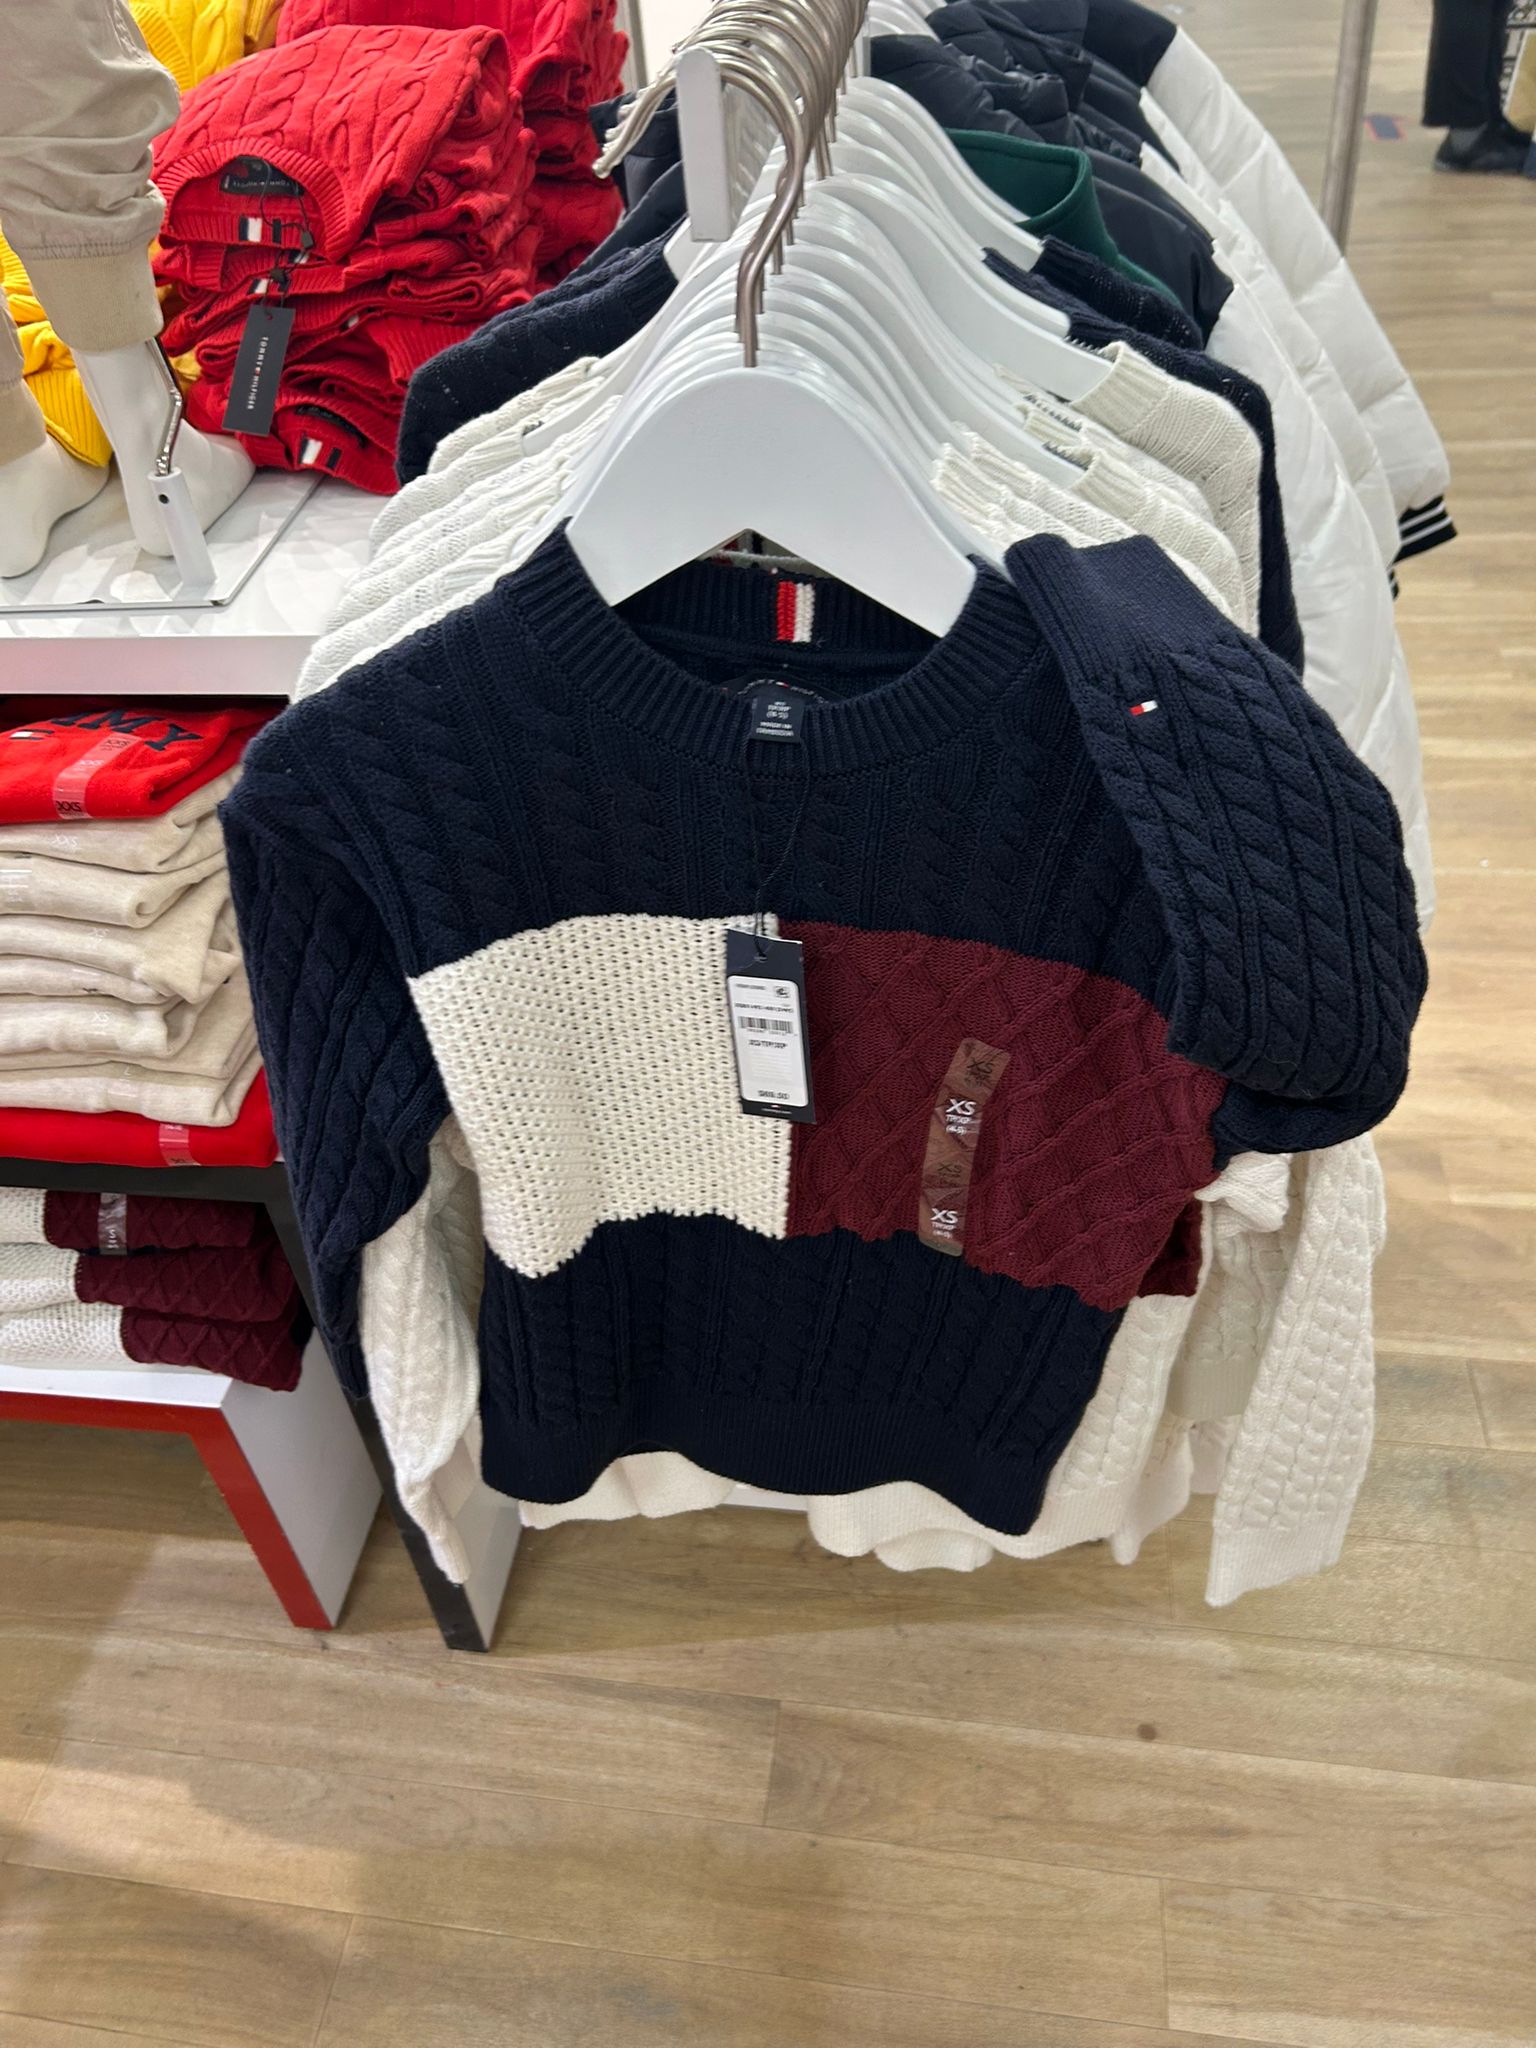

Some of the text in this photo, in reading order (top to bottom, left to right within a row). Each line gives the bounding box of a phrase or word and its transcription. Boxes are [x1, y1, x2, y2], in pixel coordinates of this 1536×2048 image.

[55, 800, 82, 812] XXS
[51, 833, 78, 848] XXS
[945, 1098, 977, 1115] XS
[930, 1207, 958, 1224] XS
